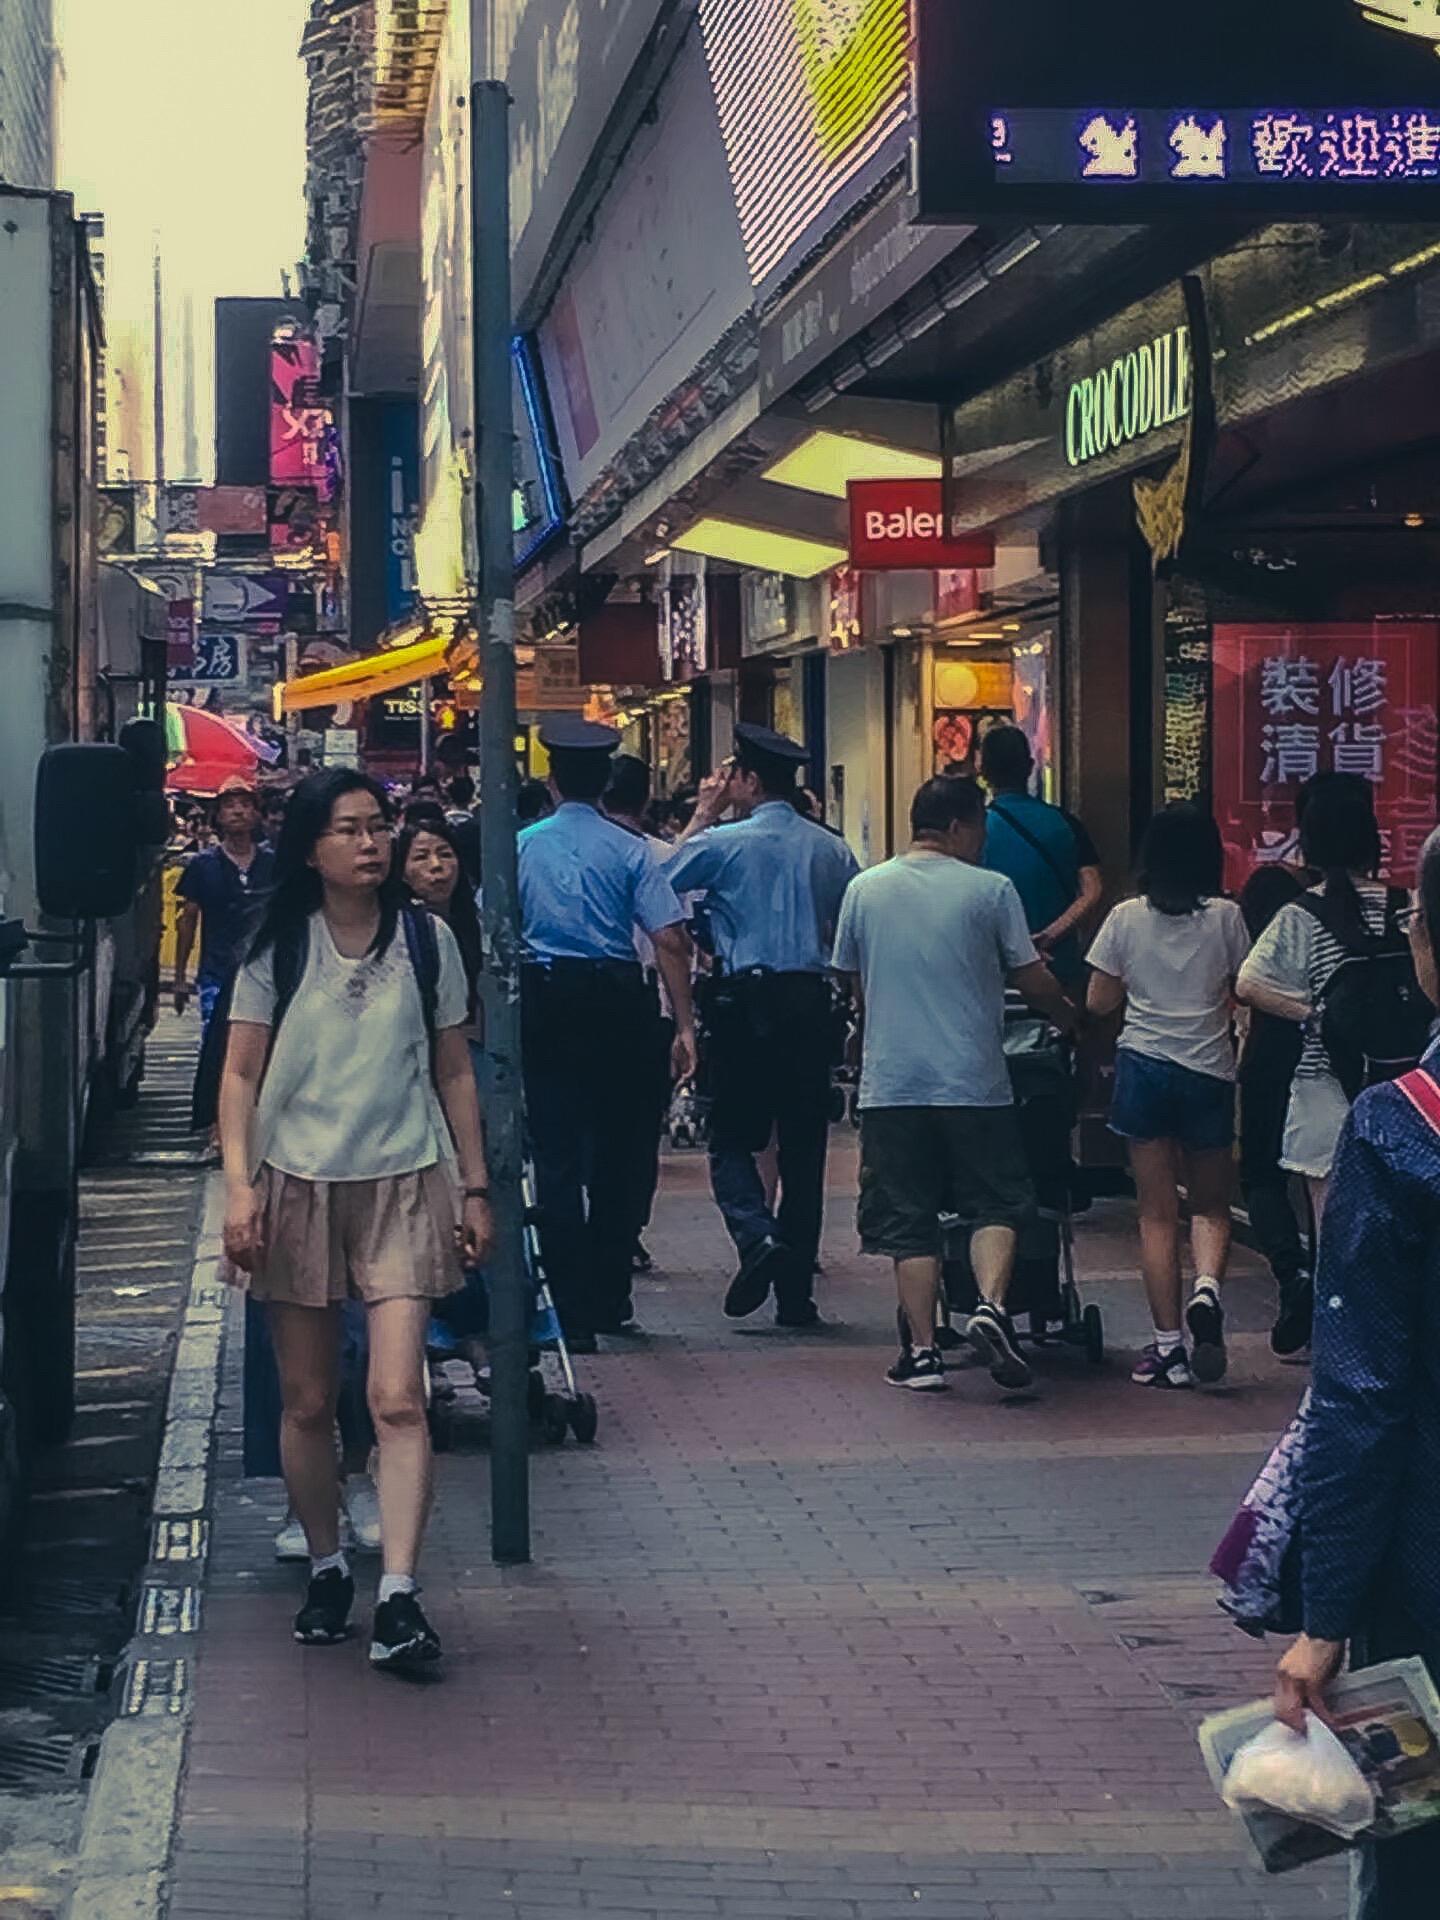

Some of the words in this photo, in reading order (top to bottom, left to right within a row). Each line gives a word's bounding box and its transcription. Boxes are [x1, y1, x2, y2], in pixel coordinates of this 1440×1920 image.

[1066, 325, 1192, 466] CROCODILE
[1261, 655, 1388, 716] 裝修
[1259, 721, 1387, 784] 清貨
